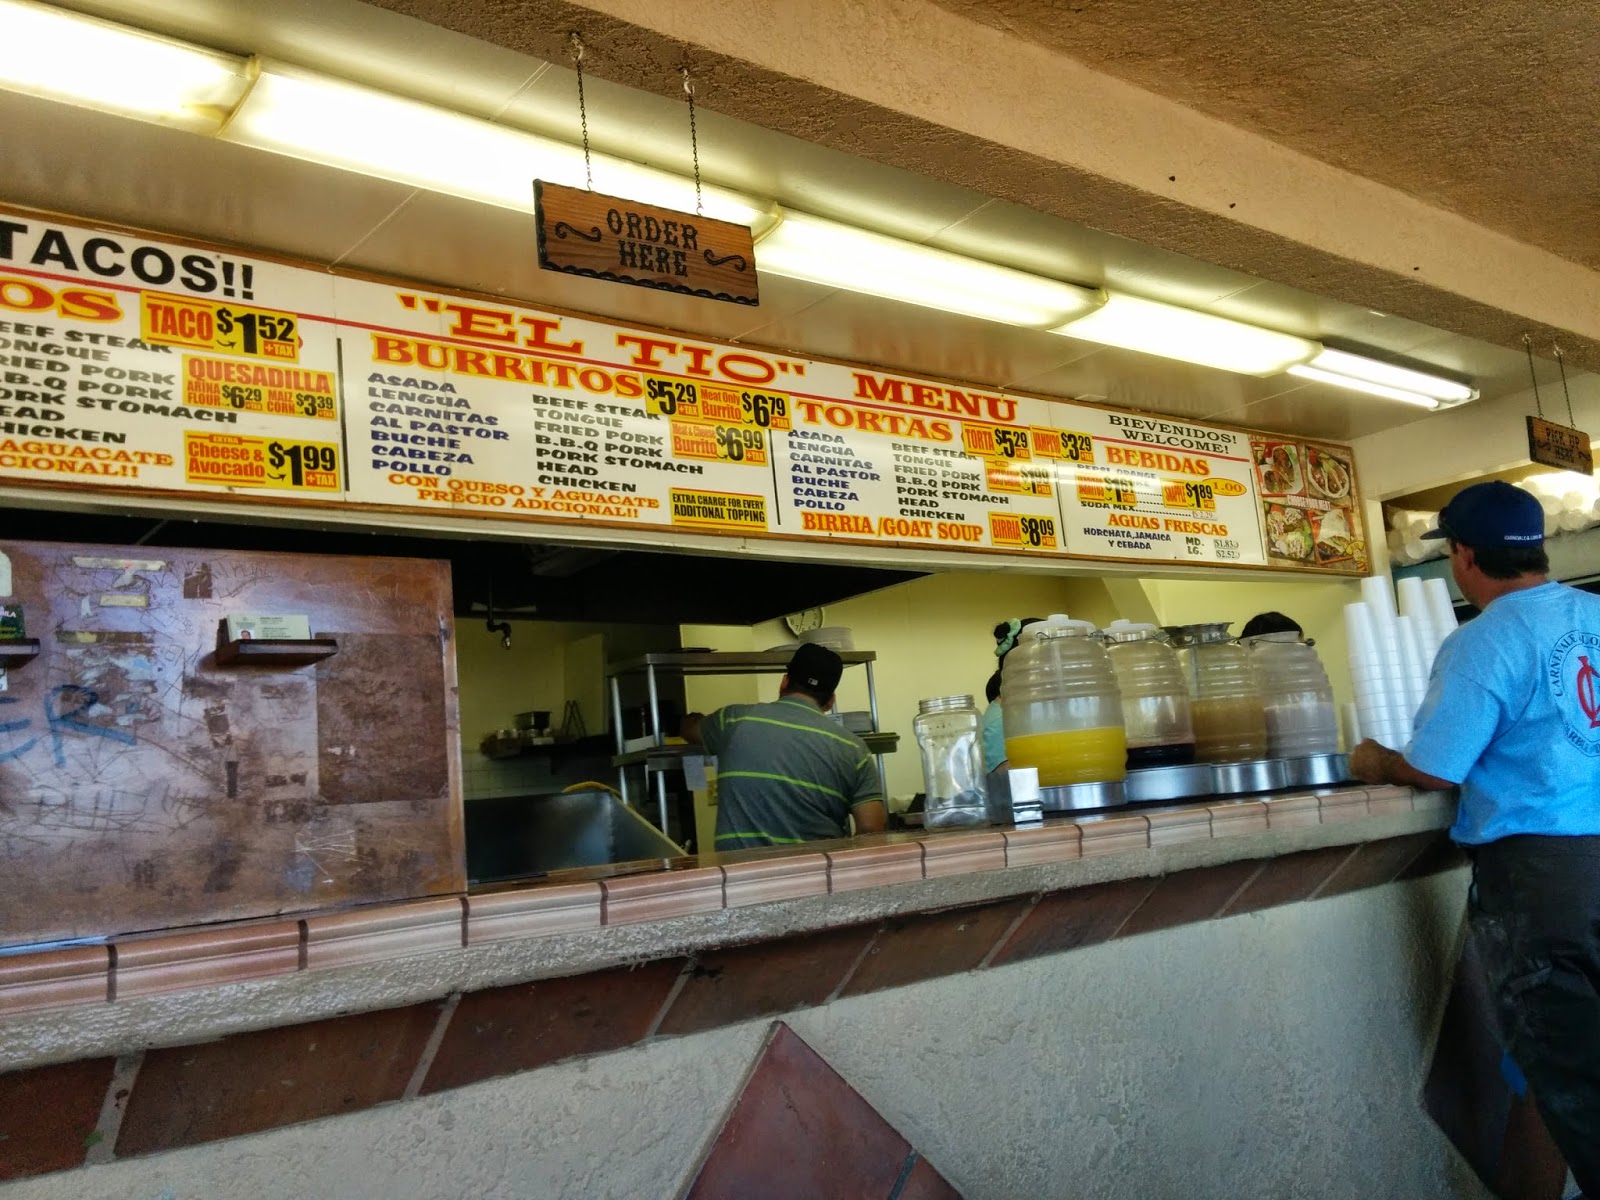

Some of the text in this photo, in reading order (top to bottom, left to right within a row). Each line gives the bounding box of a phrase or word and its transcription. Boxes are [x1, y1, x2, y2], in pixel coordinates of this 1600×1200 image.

[606, 208, 698, 250] ORDER
[617, 239, 688, 277] HERE
[147, 302, 214, 342] TACO
[81, 363, 176, 385] PORK
[188, 357, 331, 394] QUESADILLA
[371, 332, 644, 399] BURRITOS
[78, 379, 173, 400] PORK
[367, 372, 457, 394] ASADA
[368, 386, 471, 409] LENGUA
[532, 394, 588, 410] BEEF
[852, 371, 1018, 422] MENU
[76, 396, 238, 423] STOMACH
[267, 401, 296, 414] CORN
[369, 401, 499, 426] CARNITAS
[533, 407, 623, 428] TONGUE
[702, 400, 742, 420] Burrito
[370, 415, 509, 441] AL PASTOR
[796, 398, 955, 443] TORTAS
[1108, 414, 1237, 444] BIEVENIDOS!
[371, 430, 461, 449] BUCHE
[534, 421, 664, 446] FRIED PORK
[788, 429, 845, 444] ASADA
[965, 428, 995, 451] TORTA
[1121, 429, 1230, 454] WELCOME!
[0, 438, 175, 467] AGUACATE
[188, 441, 265, 462] Cheese &
[371, 445, 474, 464] CABEZA
[535, 434, 663, 458] B.B.Q PORK
[673, 436, 718, 455] Burrito
[788, 440, 855, 457] LENGUA
[891, 442, 930, 454] BEEF
[189, 456, 265, 478] Avocado
[372, 459, 452, 476] POLLO
[536, 448, 703, 475] PORK STOMACH
[537, 461, 599, 476] HEAD
[789, 452, 873, 470] CARNITAS
[893, 453, 952, 468] TONGUE
[1104, 445, 1210, 477] BEBIDAS
[791, 463, 881, 481] AL PASTOR
[792, 475, 850, 489] BUCHE
[894, 464, 938, 477] FRIED
[942, 469, 981, 482] PORK
[388, 473, 660, 509] CON QUESO Y AGUACATE
[538, 474, 637, 493] CHICKEN
[793, 487, 860, 501] CABEZA
[942, 481, 981, 492] PORK
[417, 488, 640, 519] PRECIO ADICIONAL!!
[672, 492, 764, 510] EXTRA CHARGE FOR EVERY
[794, 498, 846, 511] POLLO
[897, 486, 1009, 505] PORK STOMACH
[898, 497, 939, 508] HEAD
[726, 508, 765, 522] TOPPING
[899, 508, 965, 521] CHICKEN
[1108, 513, 1228, 537] AGUAS FRESCAS
[937, 521, 984, 542] SOUP
[992, 518, 1021, 540] BIRRIA
[1117, 540, 1152, 550] CEBADA
[1549, 633, 1576, 697] CARNEVALE
